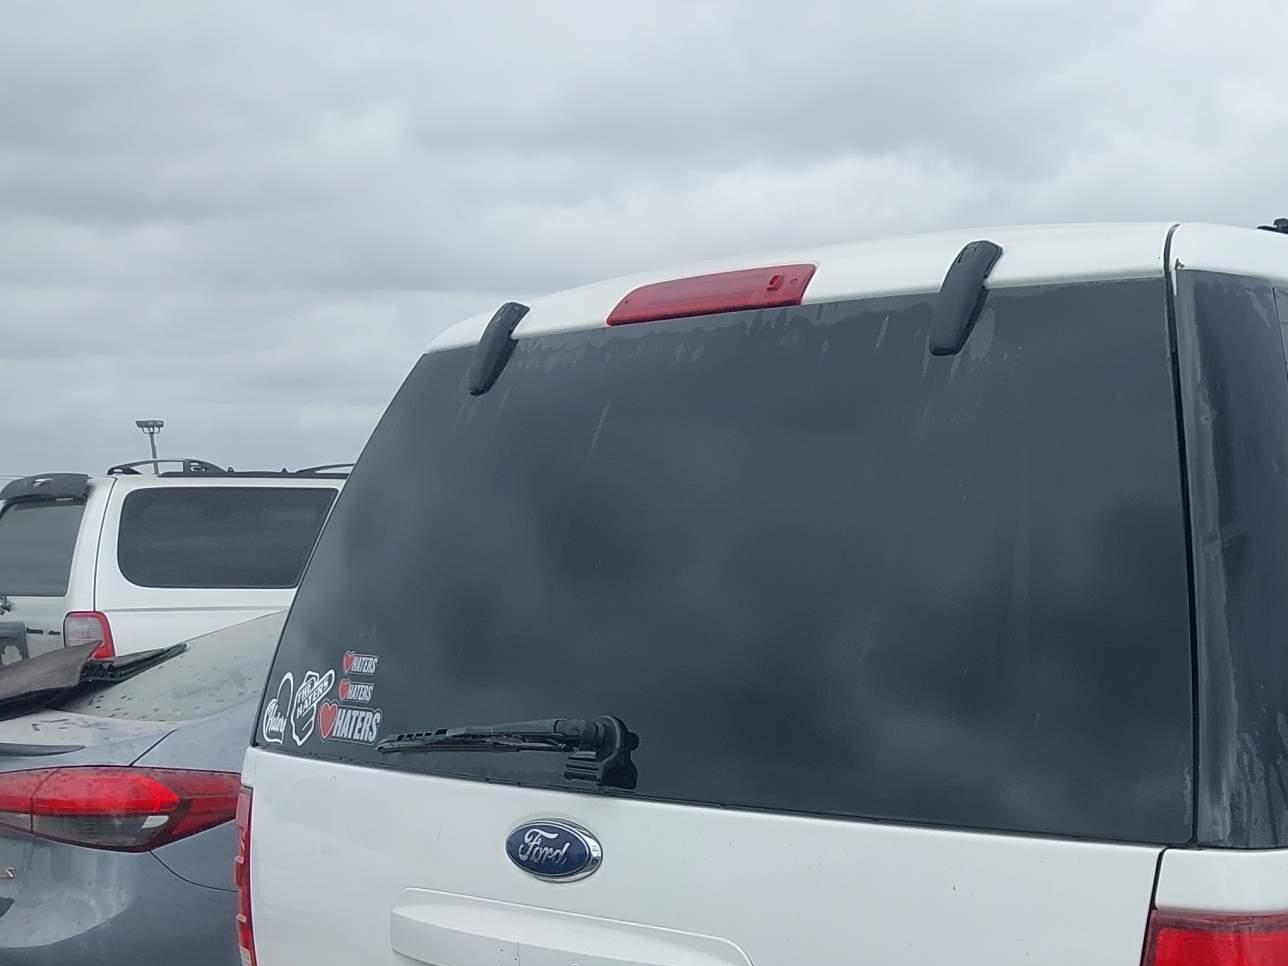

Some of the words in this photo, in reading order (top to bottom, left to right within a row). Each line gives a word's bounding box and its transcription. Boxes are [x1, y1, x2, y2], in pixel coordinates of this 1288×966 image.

[351, 656, 378, 674] HATERS
[296, 680, 313, 703] THE
[296, 678, 329, 719] HATERS
[347, 684, 374, 701] HATERS
[332, 708, 381, 742] HATERS
[518, 828, 570, 865] Ford
